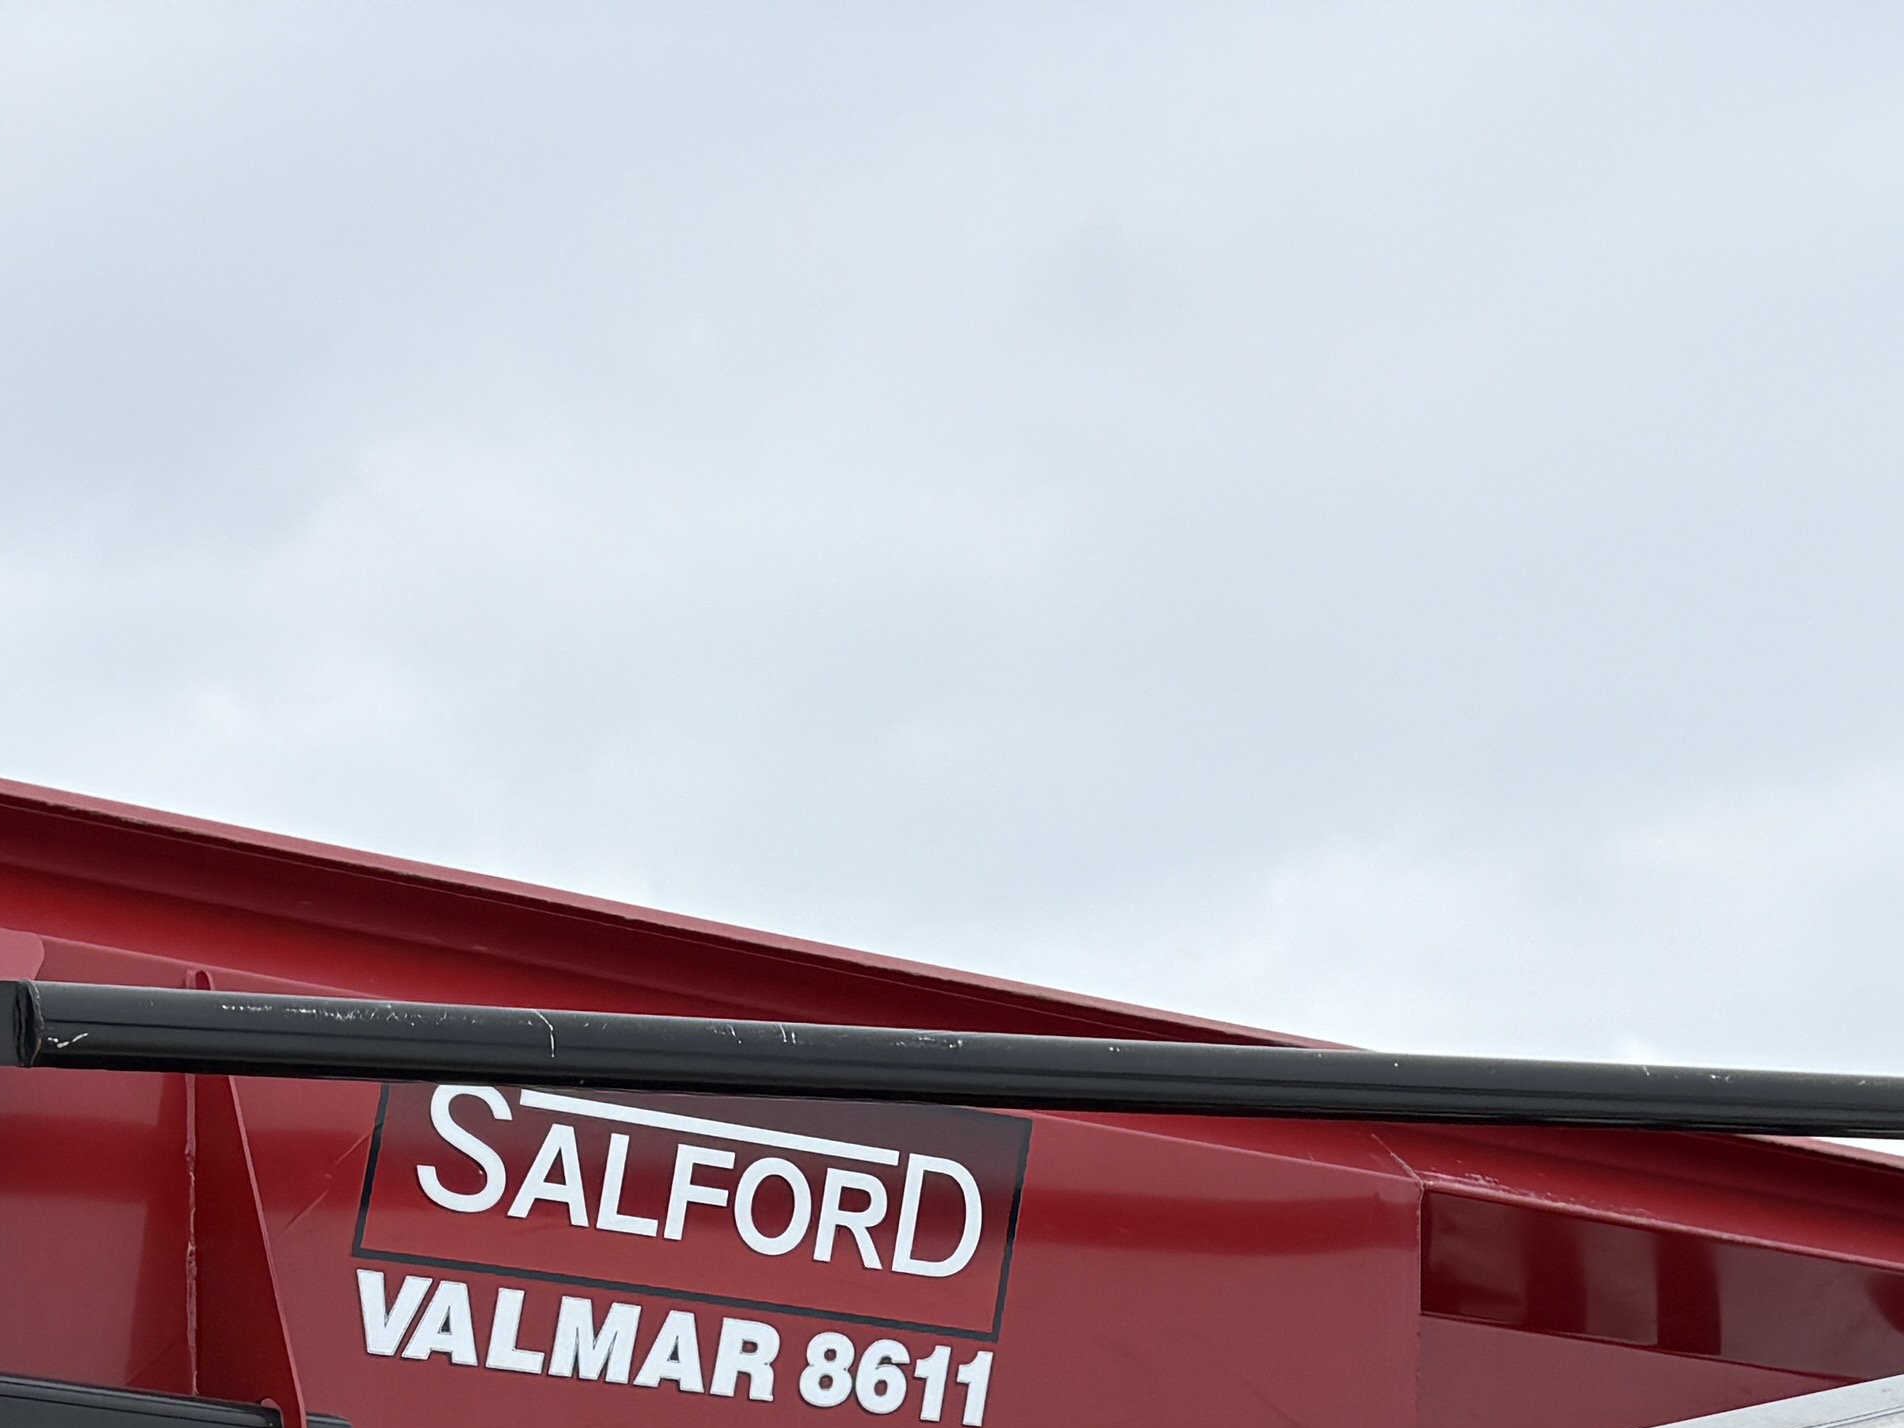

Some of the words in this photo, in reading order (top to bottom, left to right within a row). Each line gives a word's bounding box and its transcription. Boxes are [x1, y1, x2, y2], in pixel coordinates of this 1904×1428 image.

[415, 1083, 984, 1278] SALFORD
[356, 1269, 781, 1403] VALMAR
[799, 1331, 994, 1428] 8611
